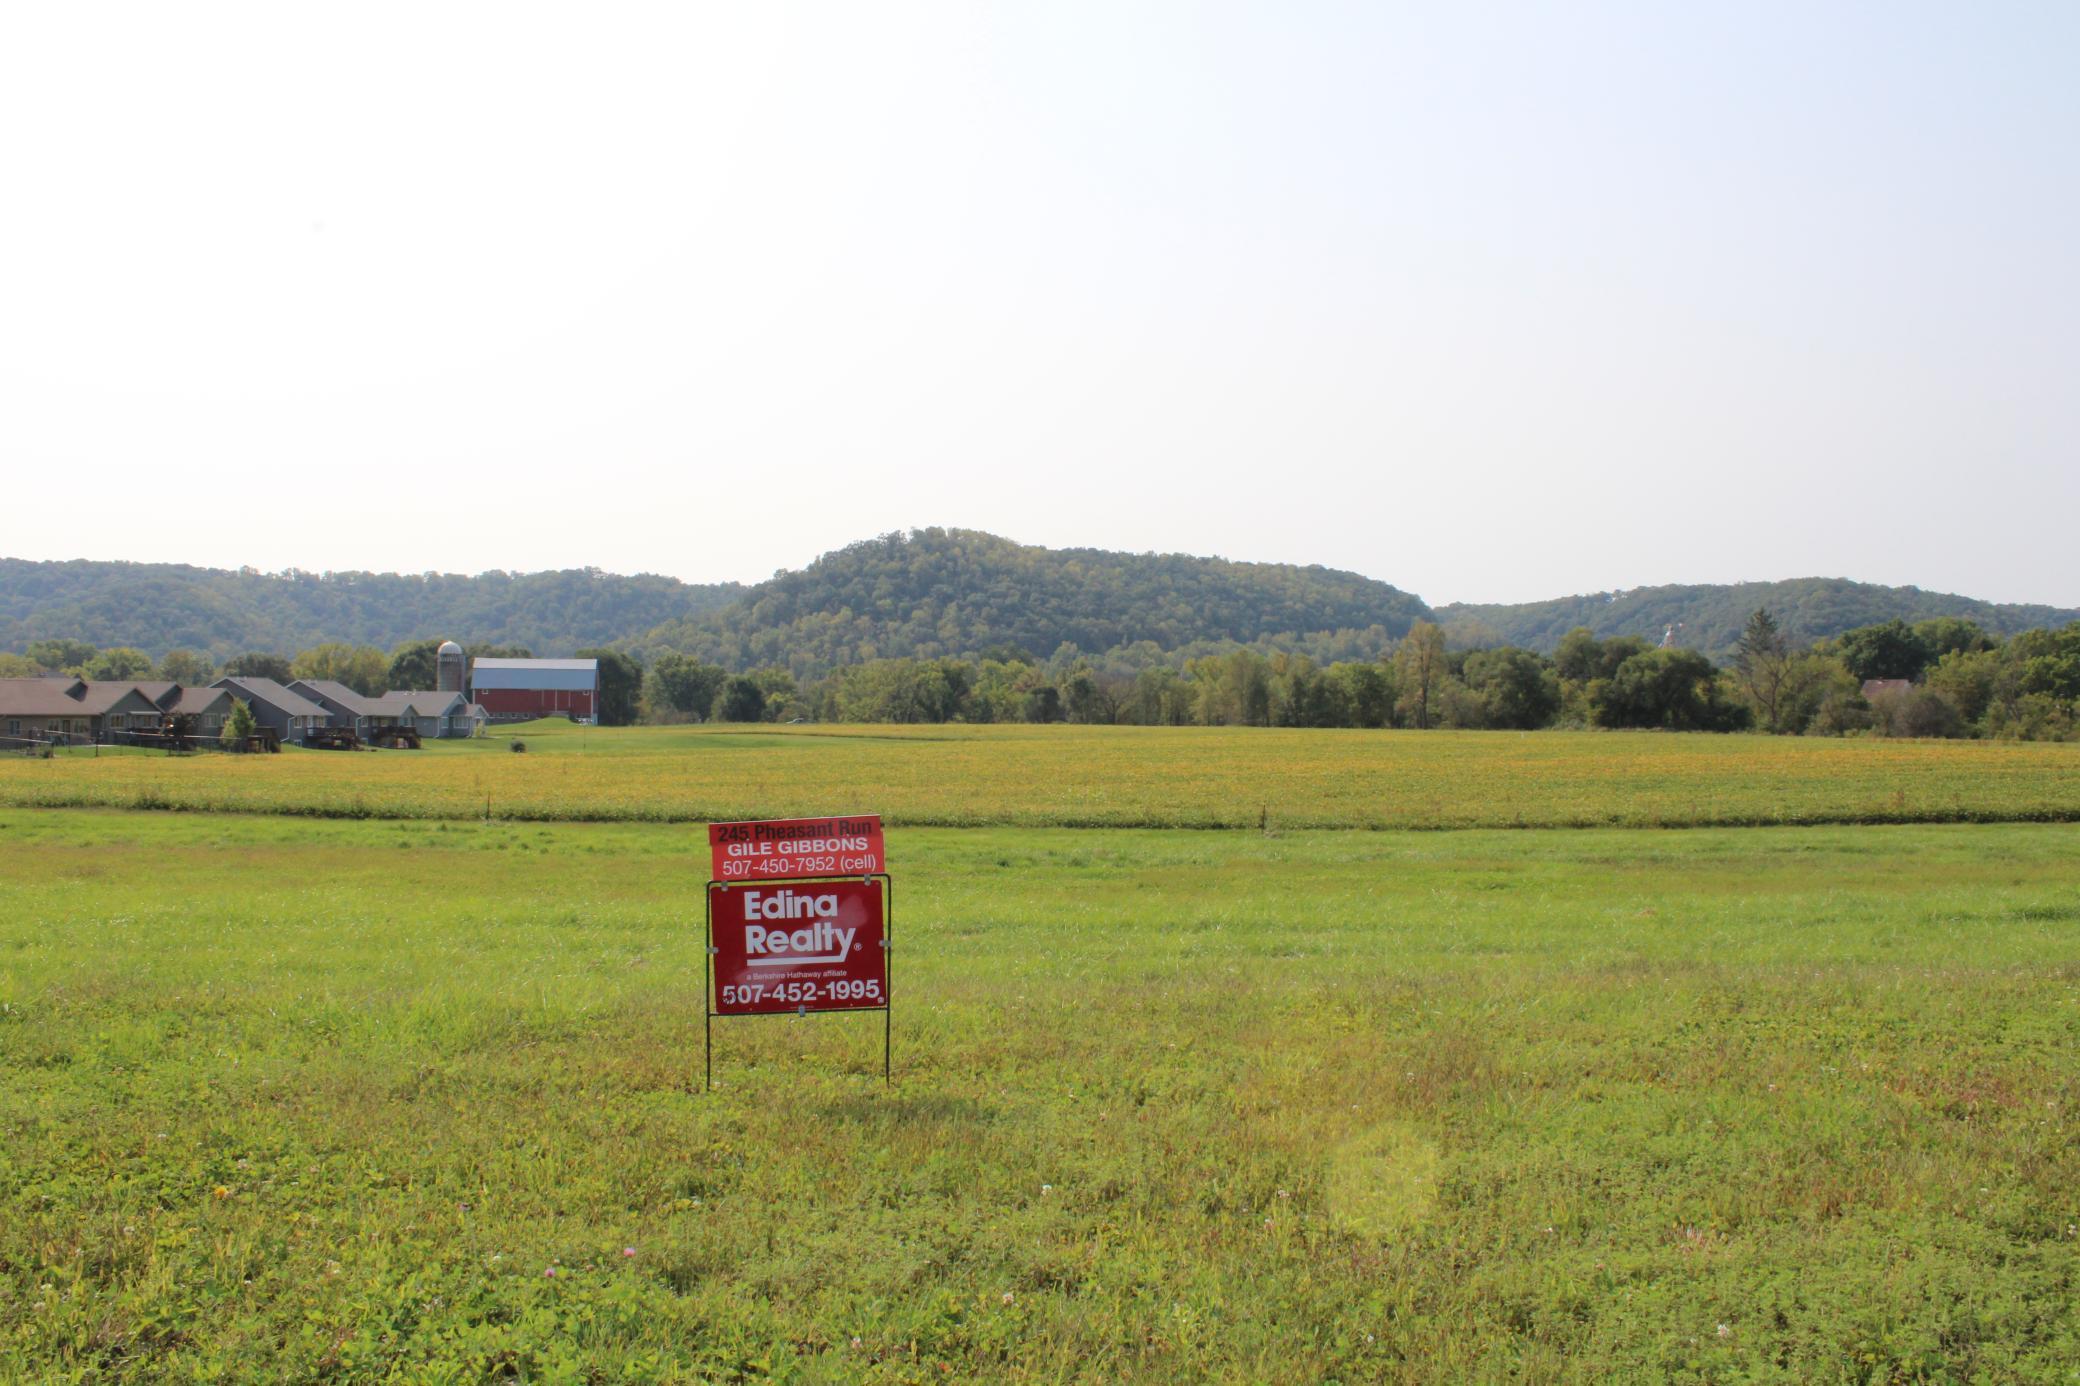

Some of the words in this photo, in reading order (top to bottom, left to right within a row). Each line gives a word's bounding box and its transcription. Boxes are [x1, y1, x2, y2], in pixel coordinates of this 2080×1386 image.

[718, 826, 749, 842] 245
[755, 823, 833, 840] Pheasant
[839, 820, 871, 835] Run
[728, 842, 772, 856] GILE
[778, 837, 868, 854] GIBBONS
[723, 857, 834, 875] 507-450-7952
[841, 855, 876, 872] (cell)
[744, 890, 837, 920] Edina
[745, 923, 856, 962] Realty
[787, 971, 821, 979] Hathaway
[823, 969, 847, 977] affiliate
[723, 980, 879, 1004] 507-452-1995
